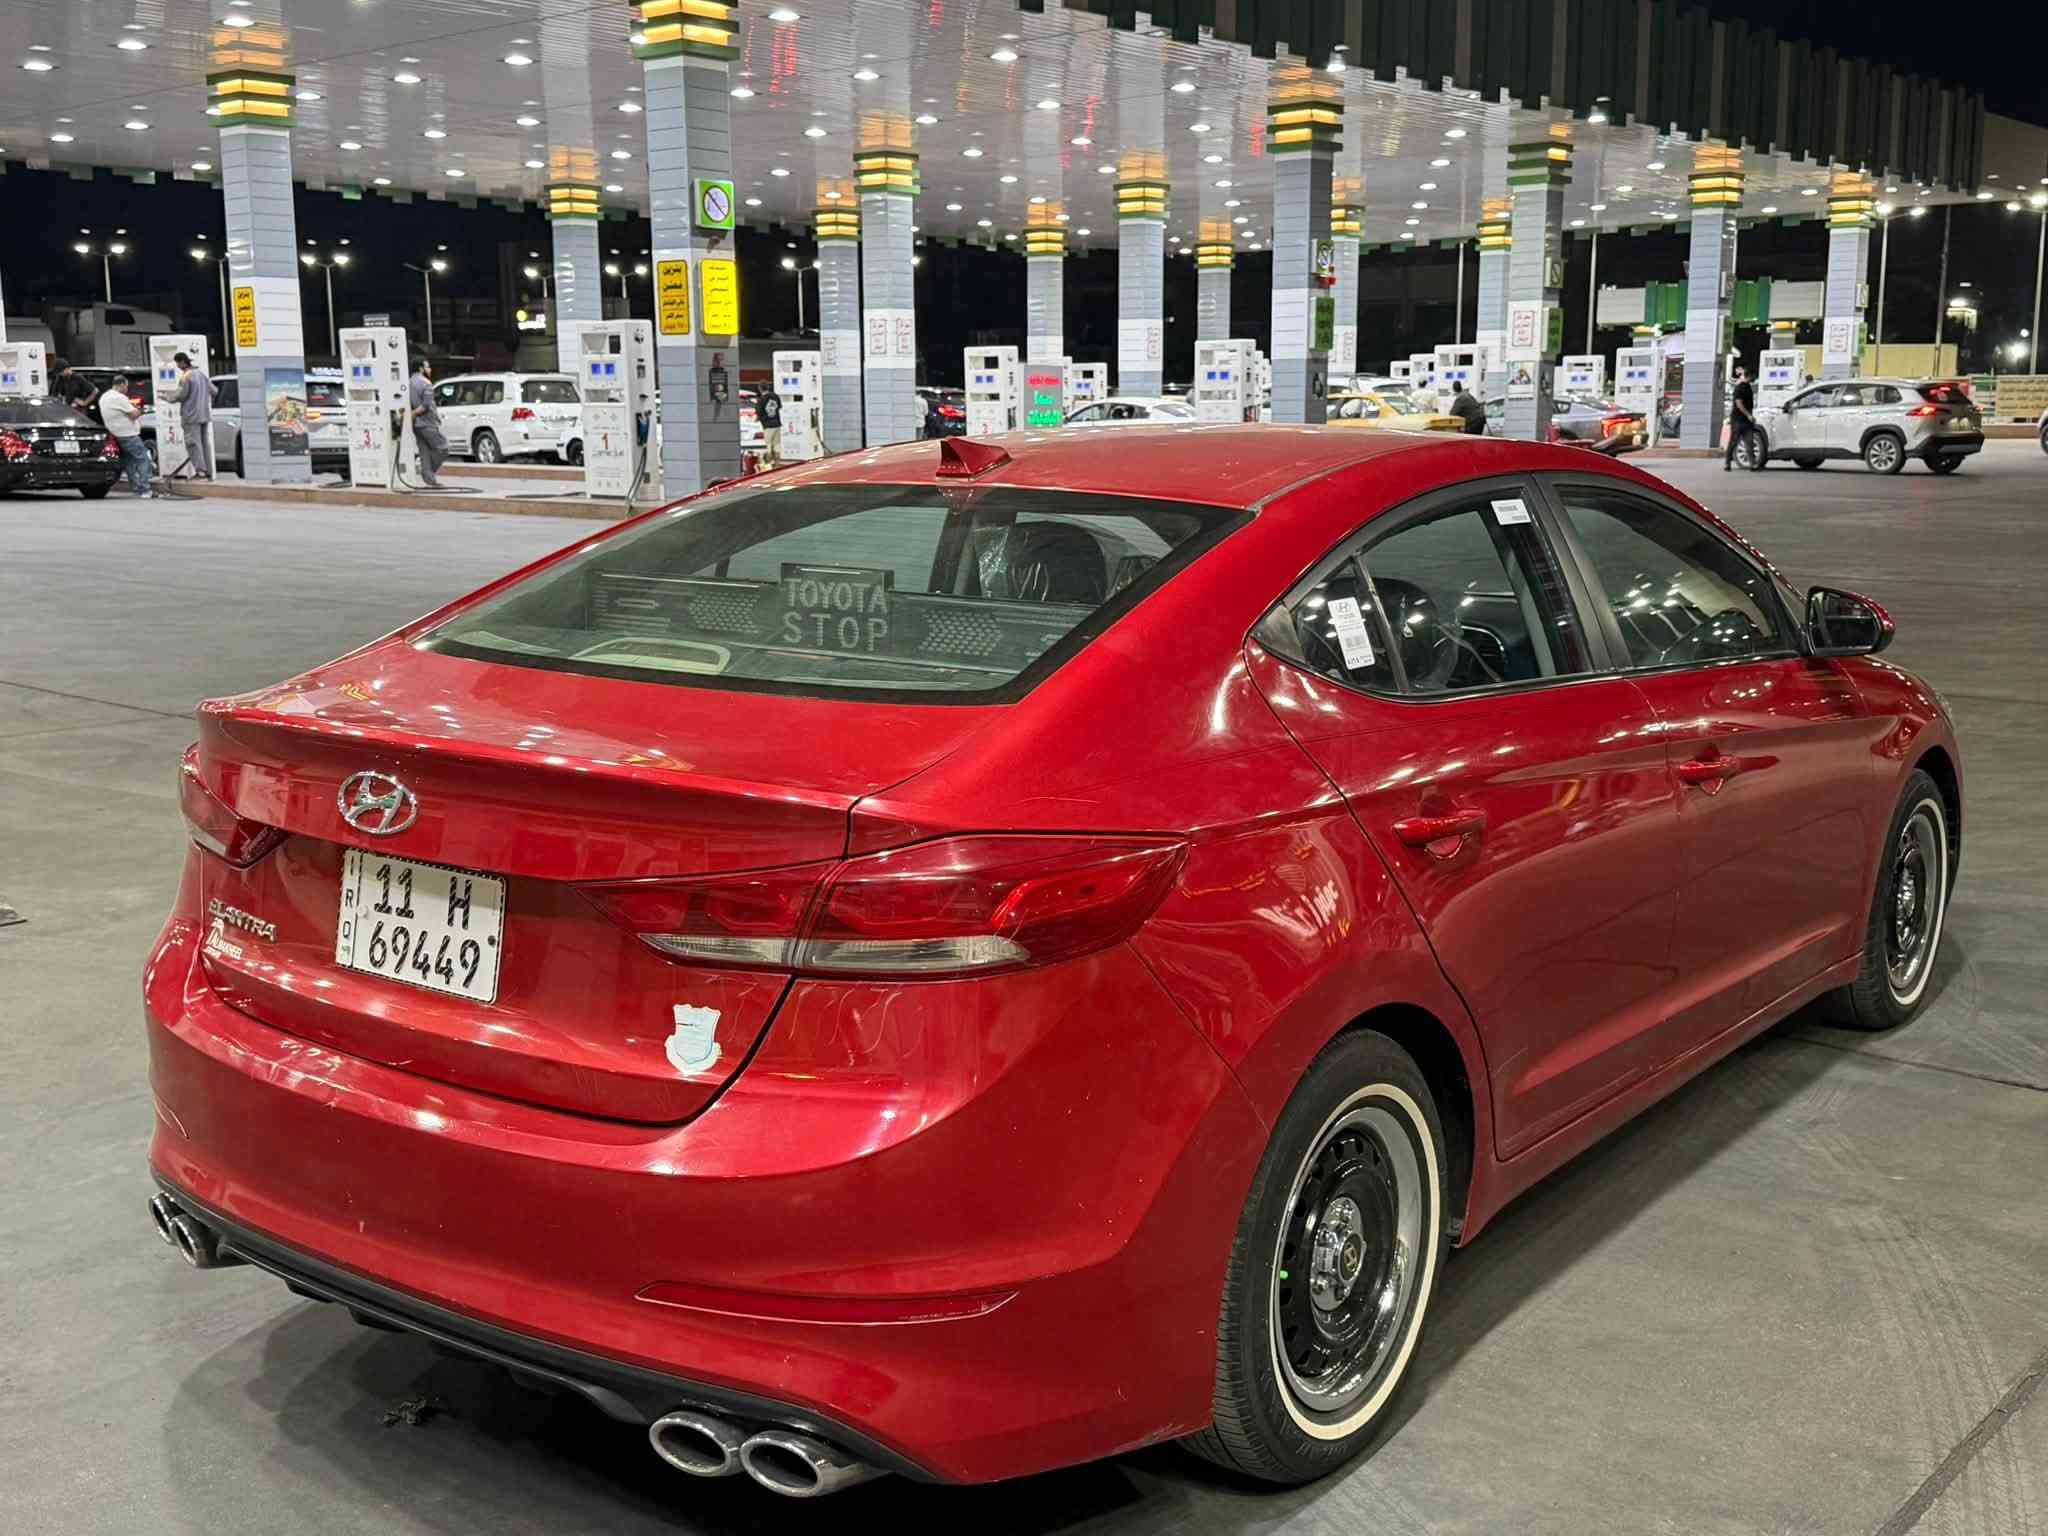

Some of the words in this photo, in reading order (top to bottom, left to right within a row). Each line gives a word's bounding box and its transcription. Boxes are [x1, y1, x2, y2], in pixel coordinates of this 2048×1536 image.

[363, 428, 372, 449] 3
[600, 431, 609, 450] 1
[783, 577, 889, 615] TOYOTA
[782, 610, 889, 652] STOP
[373, 863, 415, 920] 11
[447, 875, 473, 931] H
[208, 897, 277, 944] ELANTRA
[368, 920, 481, 988] 69449
